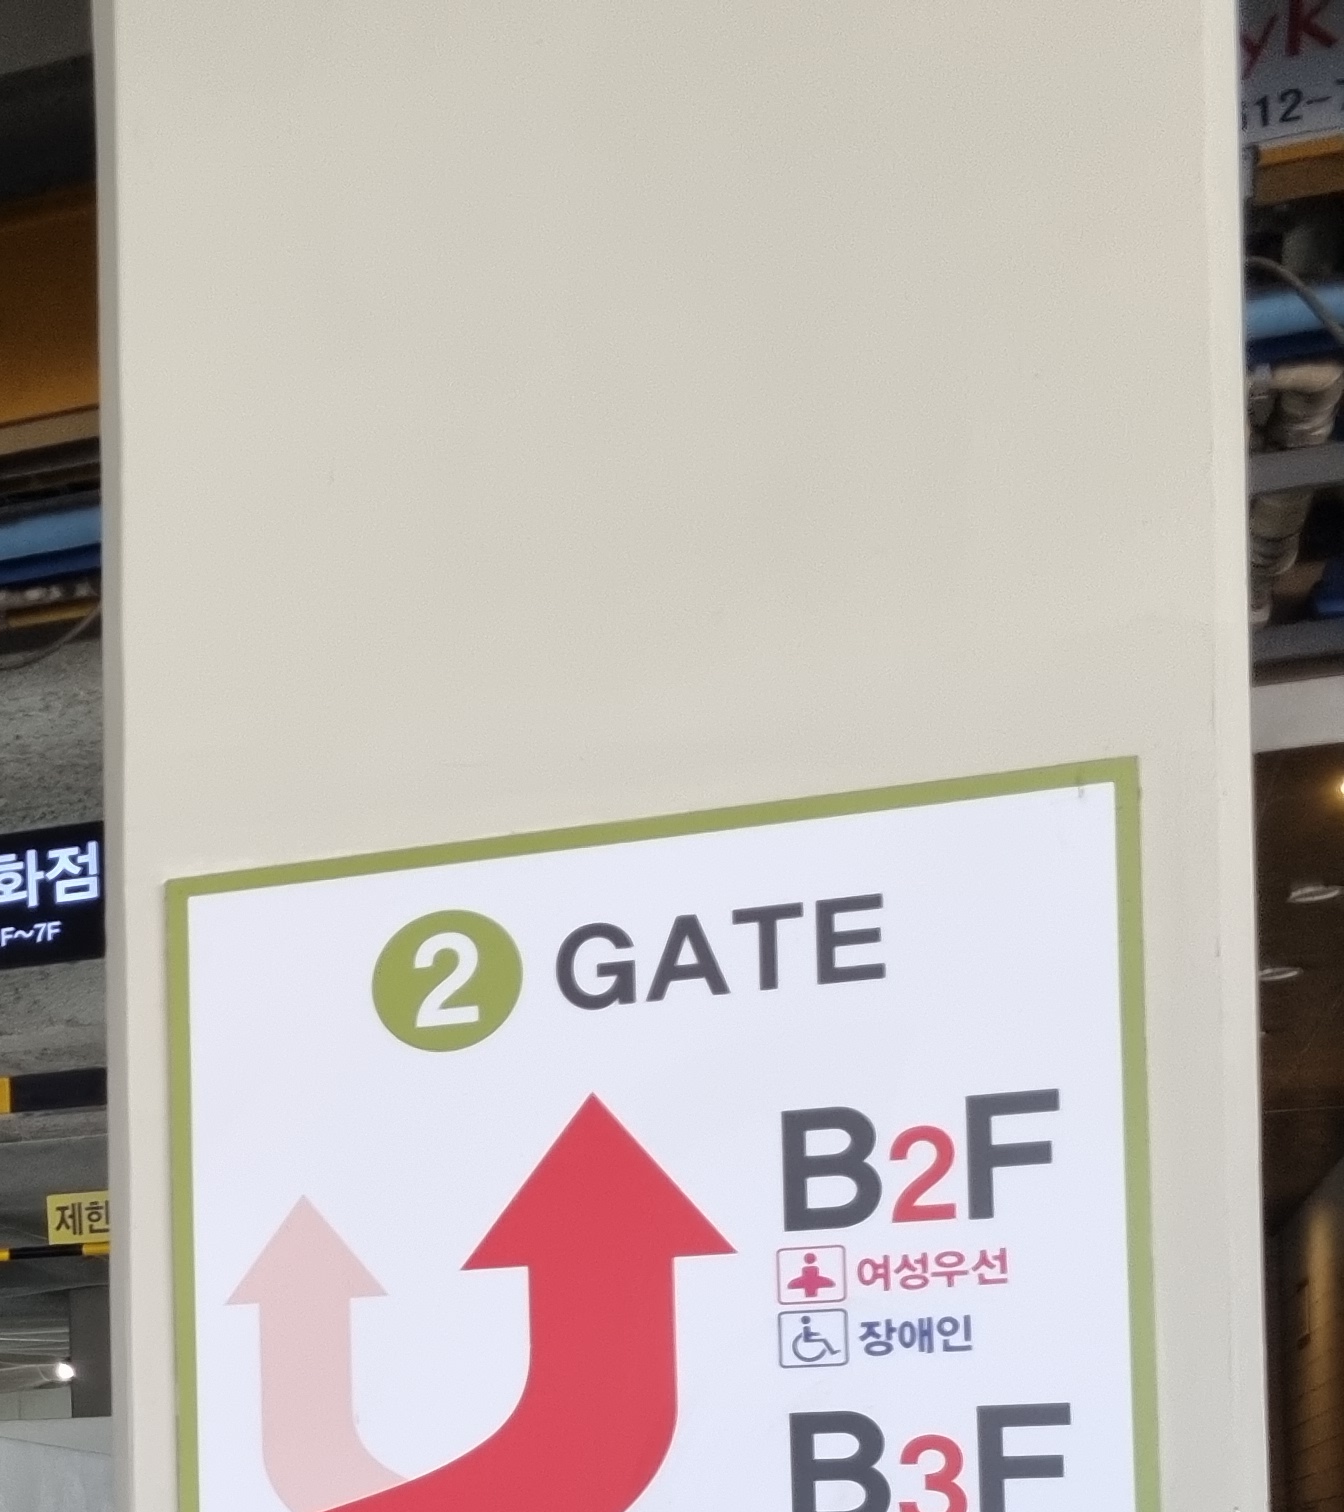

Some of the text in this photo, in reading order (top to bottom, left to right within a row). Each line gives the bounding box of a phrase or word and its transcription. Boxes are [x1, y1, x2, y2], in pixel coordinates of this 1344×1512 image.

[413, 932, 480, 1028] 2
[555, 892, 887, 1011] GATE
[780, 1088, 1061, 1232] B2F
[857, 1247, 1010, 1292] 여성우선
[858, 1315, 974, 1357] 장애인
